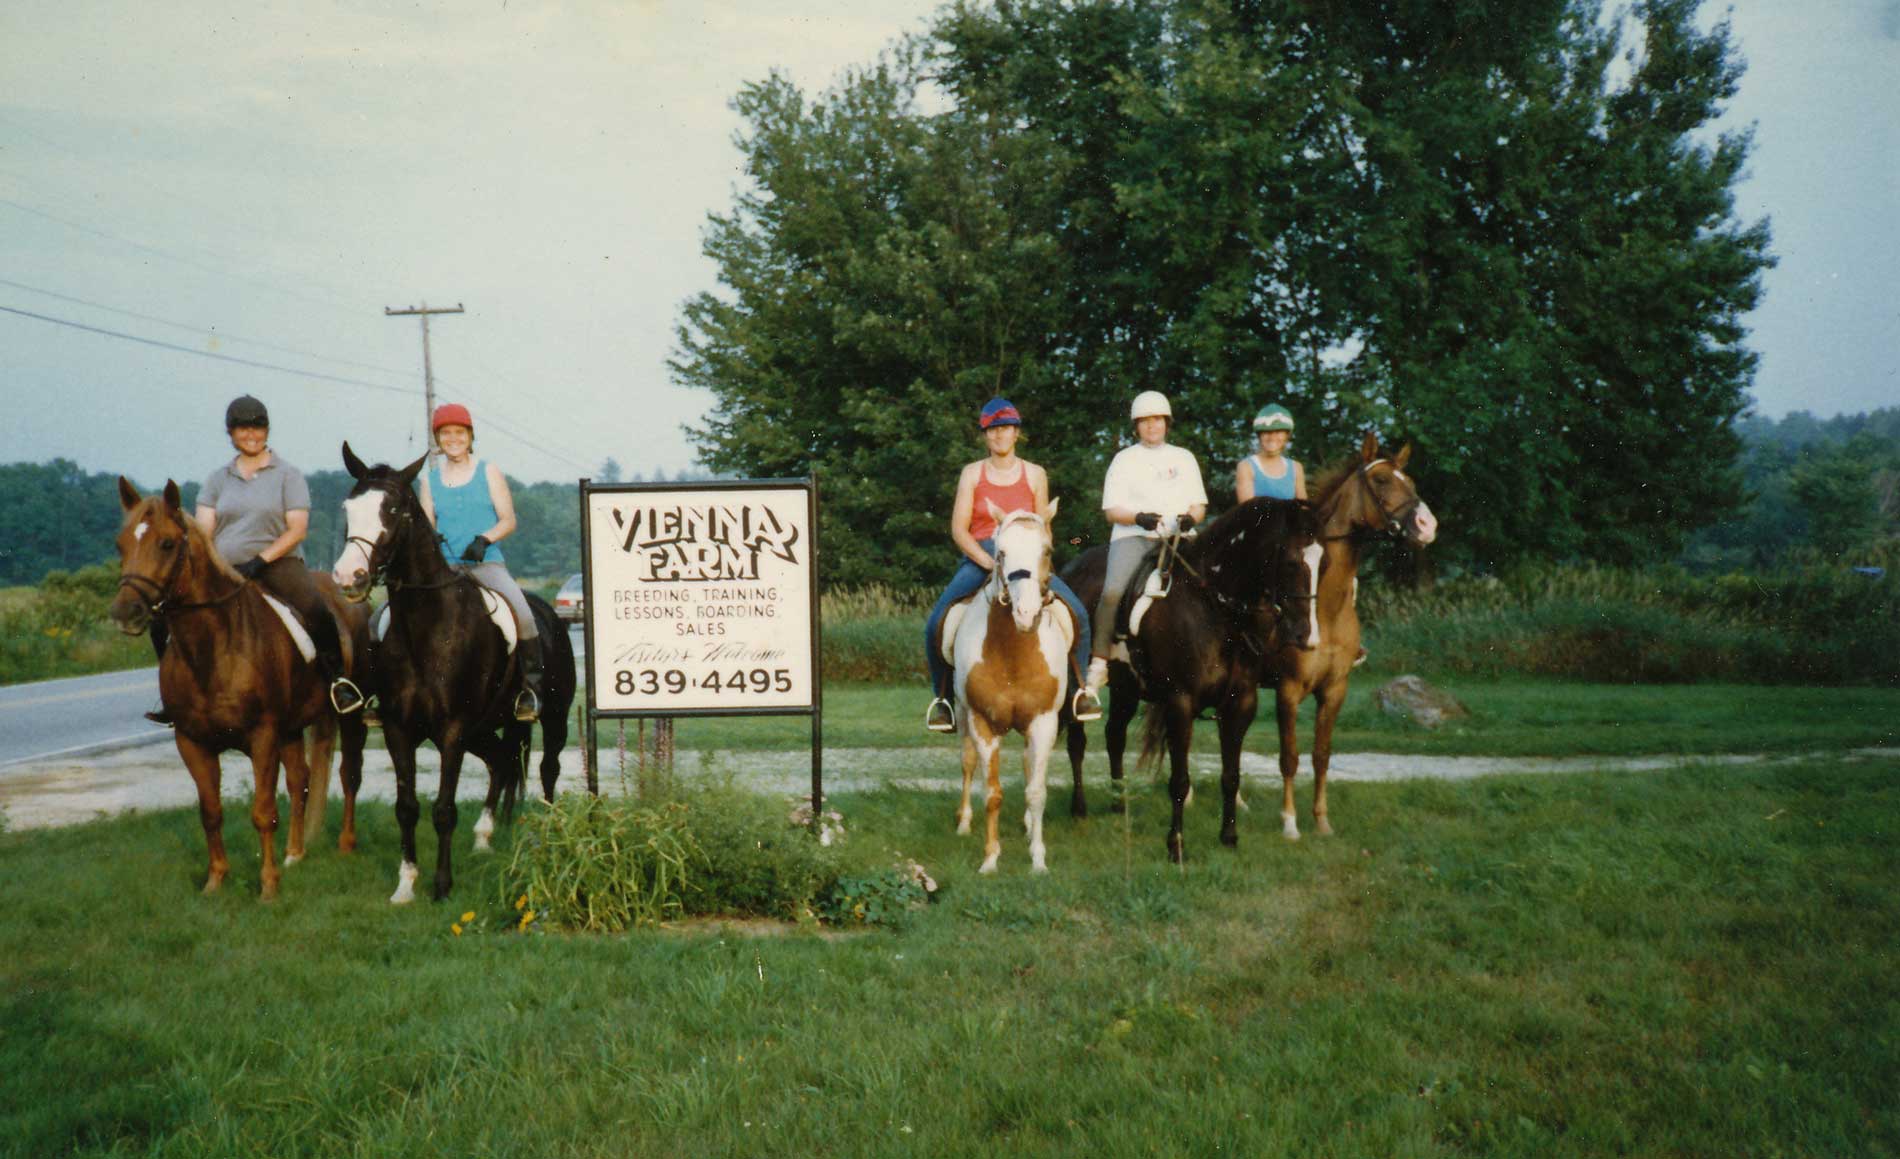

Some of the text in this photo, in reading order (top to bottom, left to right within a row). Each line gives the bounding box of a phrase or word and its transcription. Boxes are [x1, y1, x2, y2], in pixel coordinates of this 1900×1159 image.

[608, 504, 798, 564] VIENNA
[638, 541, 760, 582] FARM
[613, 586, 784, 603] BREEDING, TRAINING,
[676, 622, 726, 636] SALES
